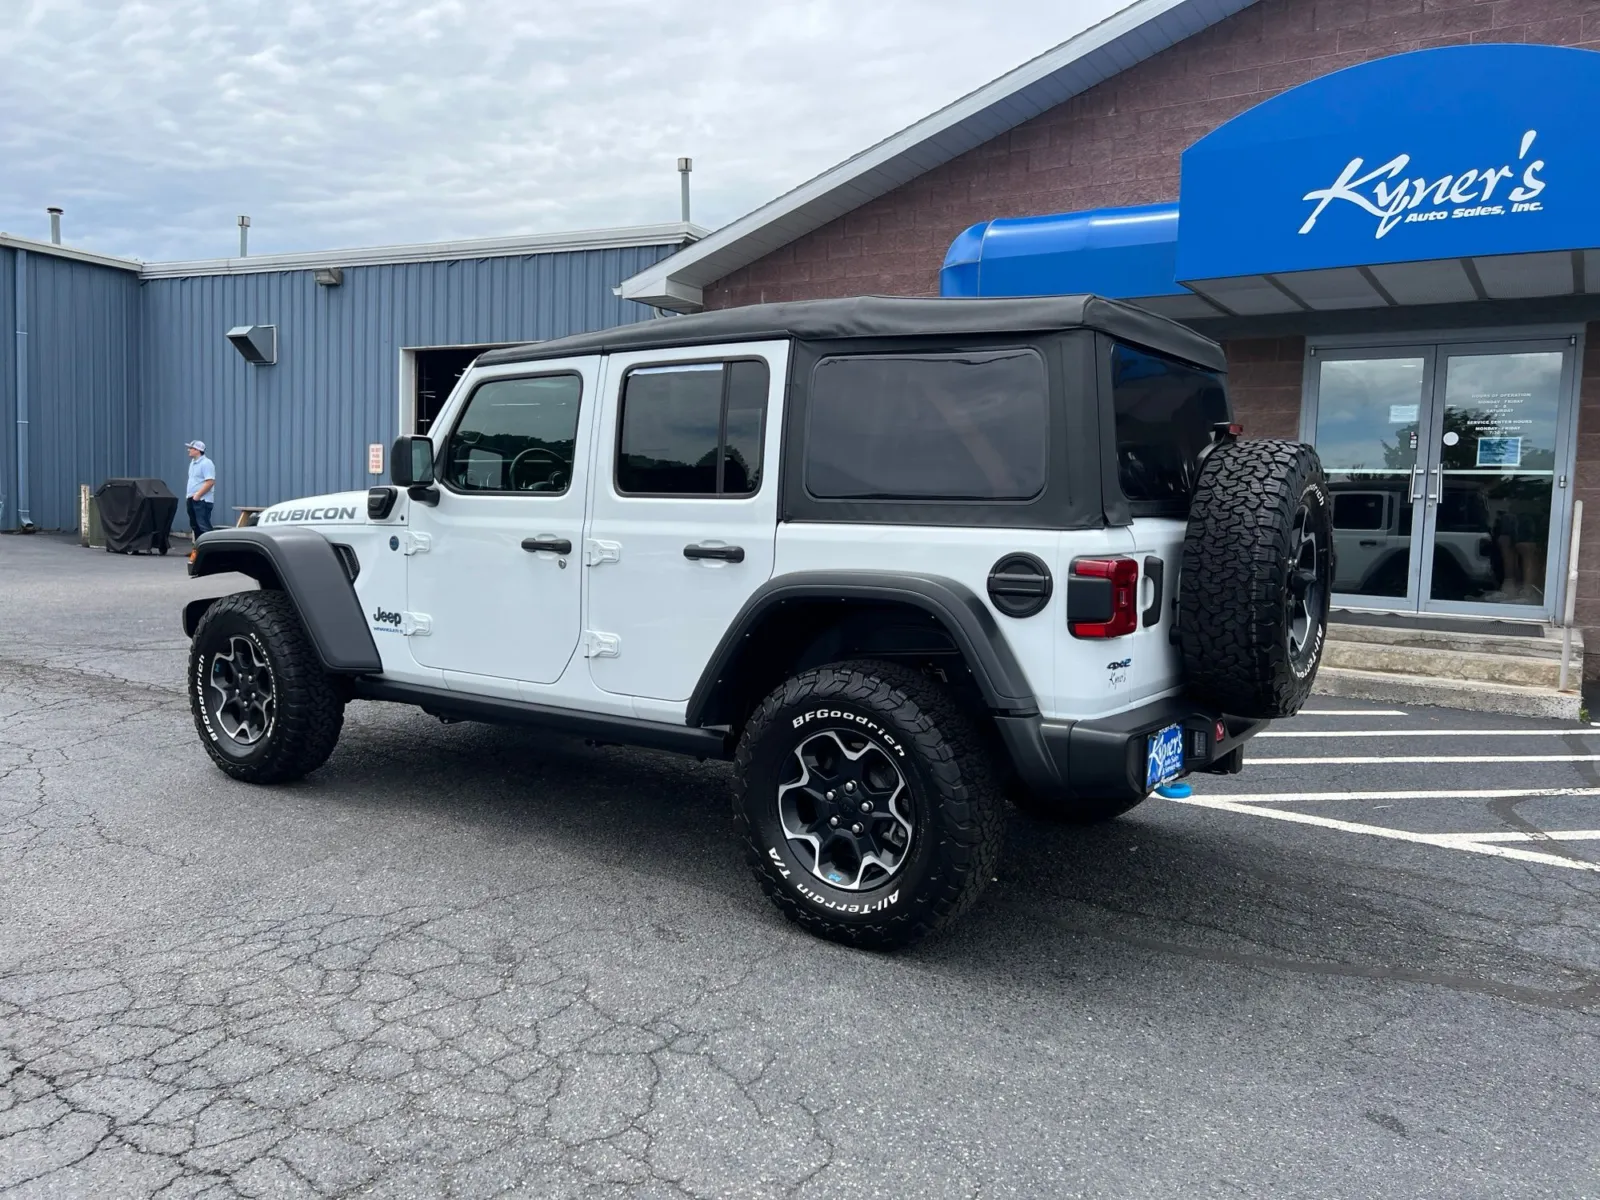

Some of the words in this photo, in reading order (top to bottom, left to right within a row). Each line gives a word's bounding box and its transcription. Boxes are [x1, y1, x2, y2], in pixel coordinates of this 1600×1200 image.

[1298, 129, 1546, 240] Kyner's
[1404, 210, 1448, 223] Auto
[1451, 205, 1506, 218] Sales,
[1511, 201, 1543, 213] Inc.
[264, 507, 358, 524] RUBICON
[373, 606, 402, 627] Jeep
[792, 708, 905, 757] BFGoodrich
[1147, 728, 1183, 777] Kyner's
[768, 847, 791, 880] T/A
[796, 882, 900, 915] All-Terrain
